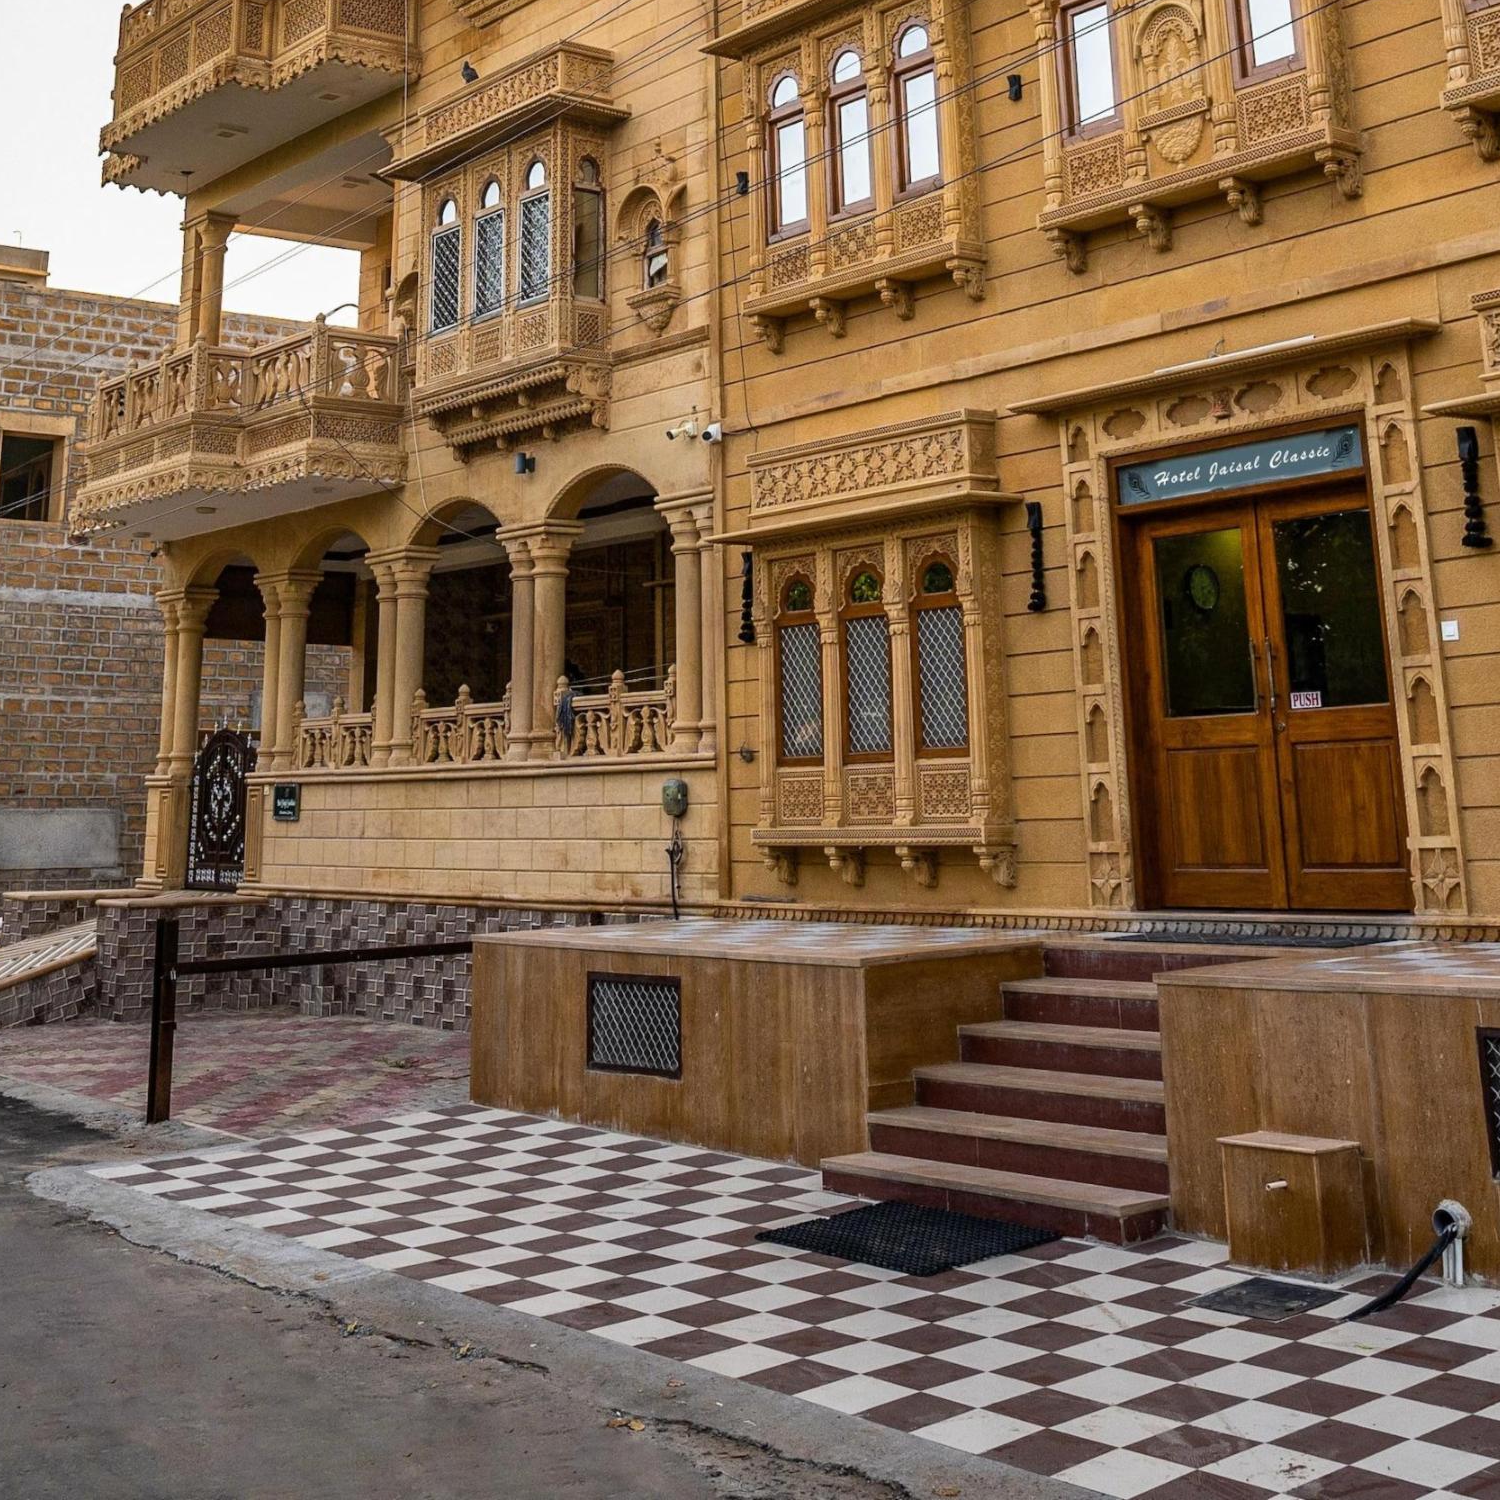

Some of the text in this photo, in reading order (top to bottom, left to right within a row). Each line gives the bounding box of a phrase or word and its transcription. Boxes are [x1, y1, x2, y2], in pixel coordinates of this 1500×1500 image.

[1153, 446, 1331, 487] Hotel Jaisal Classic
[1292, 692, 1319, 707] PUSH
